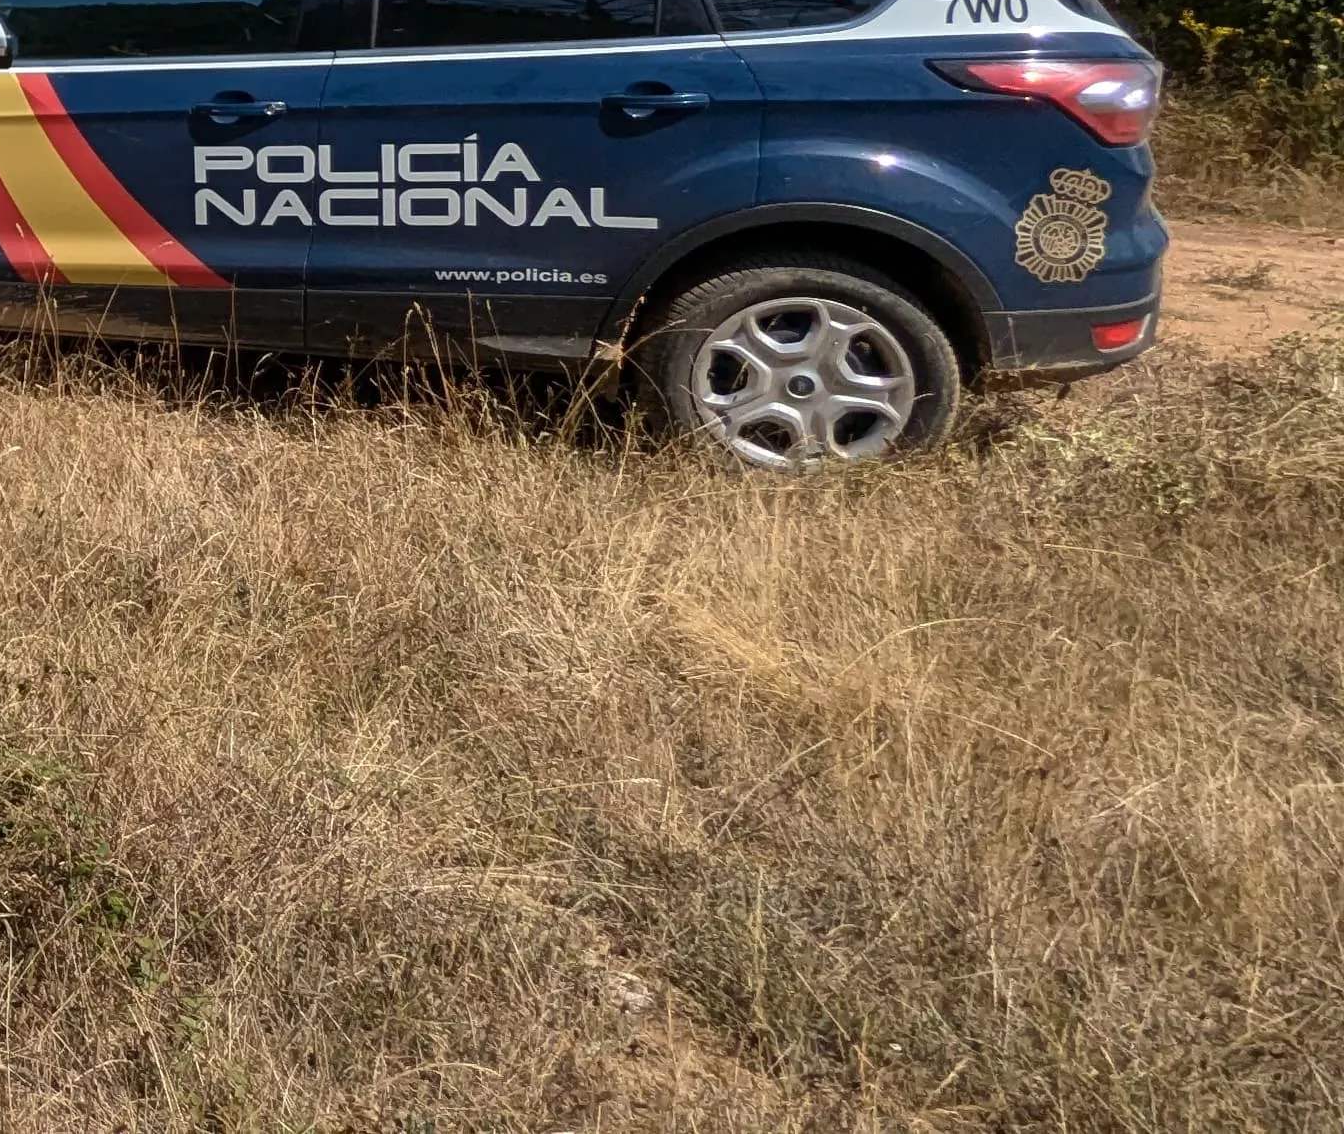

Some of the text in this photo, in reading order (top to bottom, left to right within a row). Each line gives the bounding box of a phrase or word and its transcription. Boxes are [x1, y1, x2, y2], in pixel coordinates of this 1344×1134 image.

[193, 132, 541, 184] POLICÍA
[194, 187, 658, 230] NACIONAL
[434, 267, 608, 285] www.policia.es
